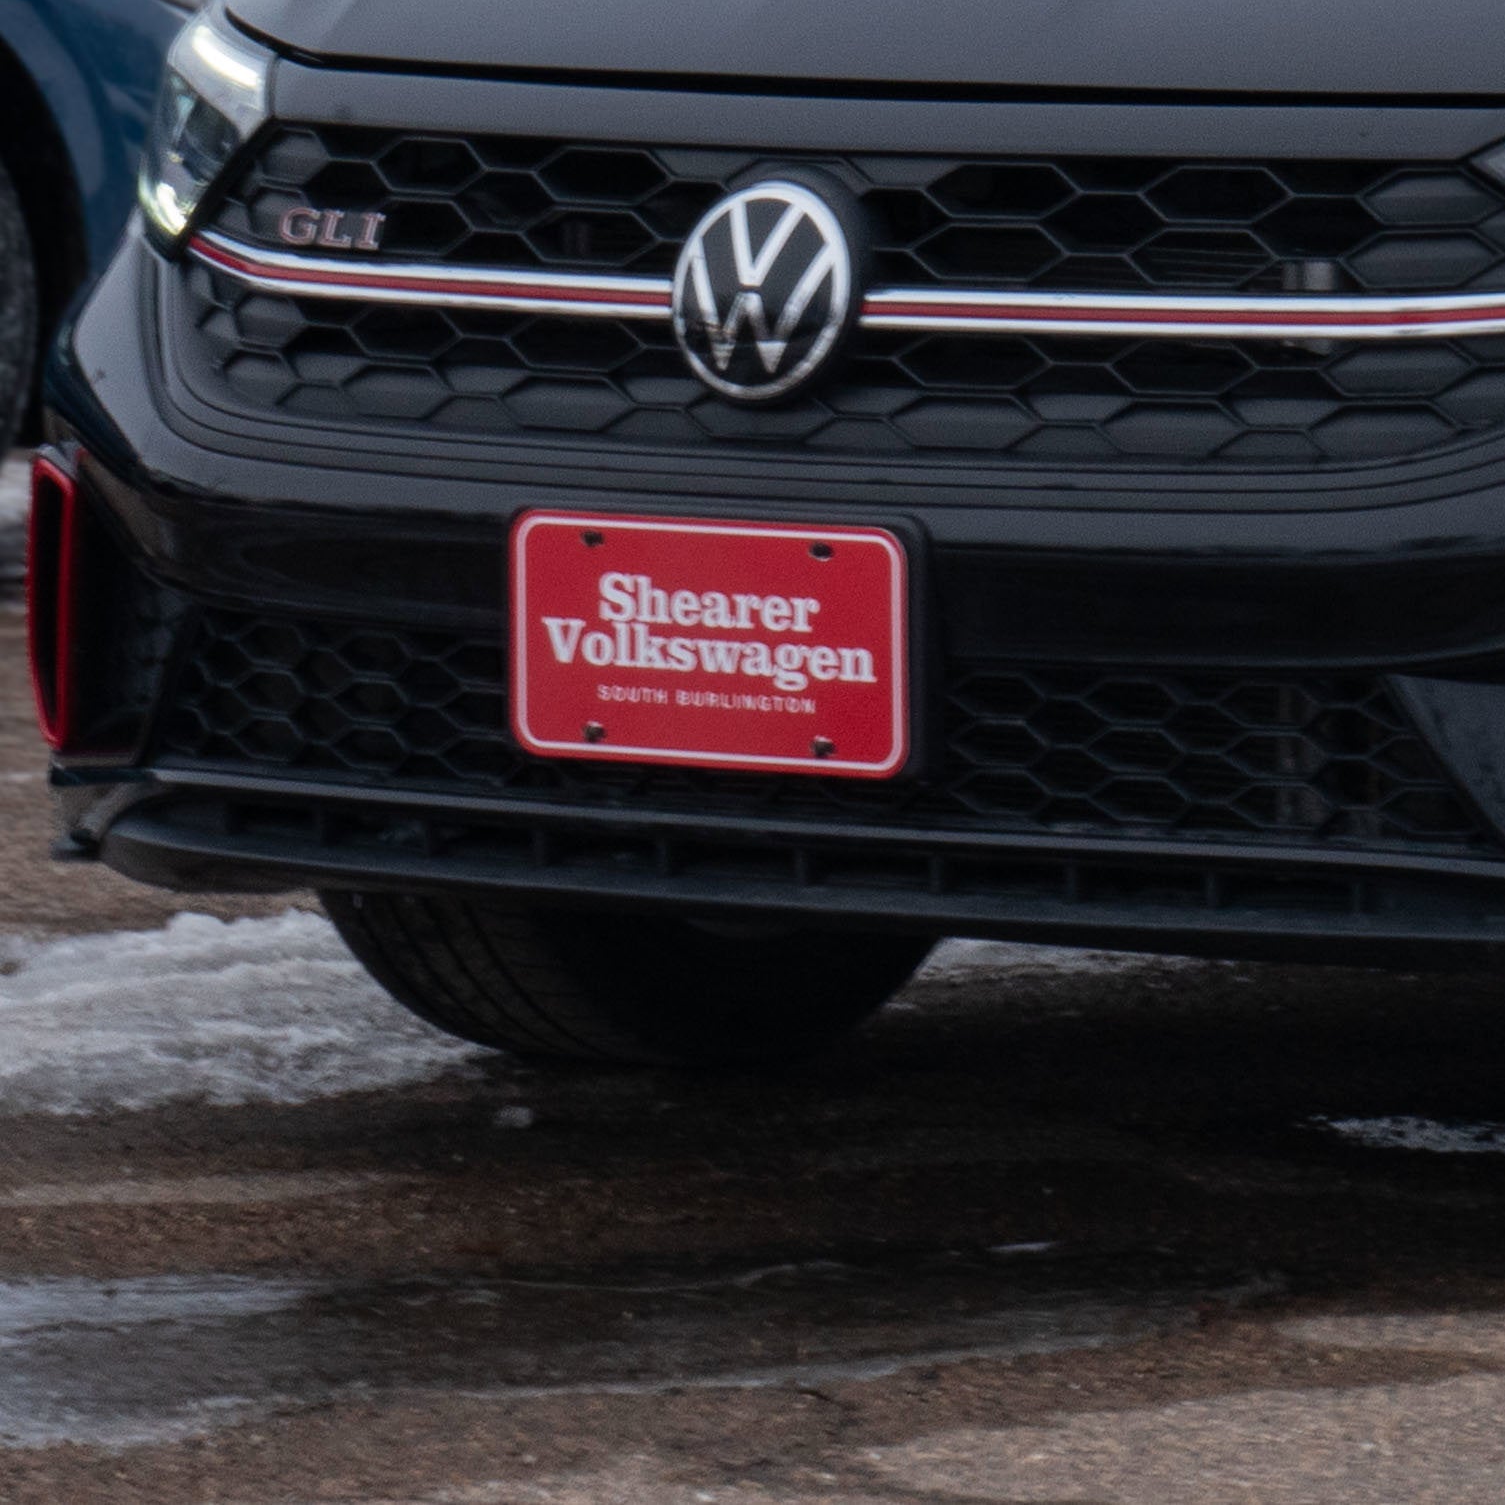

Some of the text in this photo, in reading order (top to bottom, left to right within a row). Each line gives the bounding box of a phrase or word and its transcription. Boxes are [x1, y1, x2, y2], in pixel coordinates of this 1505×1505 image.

[277, 206, 387, 251] GLI
[598, 570, 821, 633] Shearer
[541, 615, 878, 691] Volkswagen
[597, 683, 817, 714] SOUTH BURLINGTON
